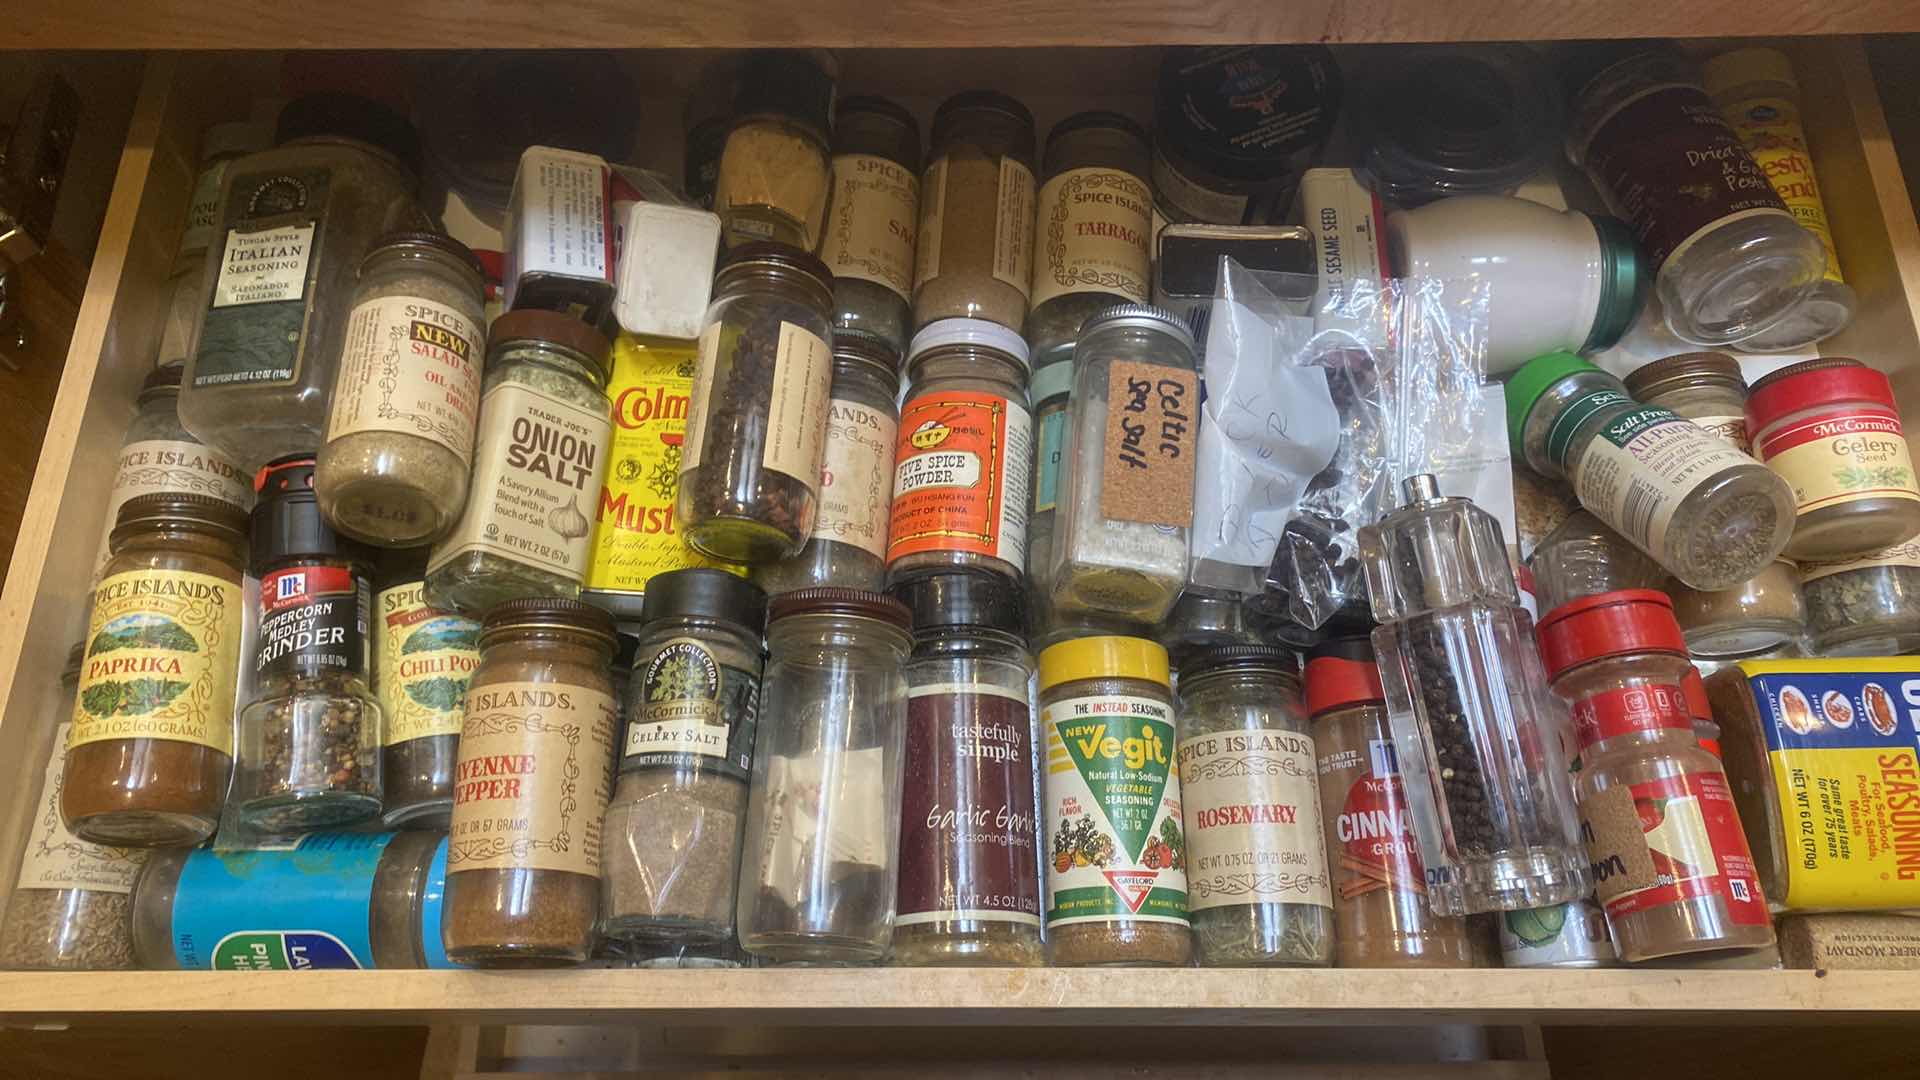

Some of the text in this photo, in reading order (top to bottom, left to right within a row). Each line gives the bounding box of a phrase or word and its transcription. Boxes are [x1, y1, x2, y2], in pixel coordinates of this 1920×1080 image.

[1320, 207, 1342, 274] SESAME SEED
[229, 245, 304, 263] ITALIAN
[227, 260, 299, 276] SEASONING
[404, 304, 466, 332] SPICE
[415, 324, 467, 356] NEW
[410, 342, 460, 370] SALAD
[424, 370, 446, 389] OIL
[528, 406, 562, 427] TRADER
[1156, 379, 1189, 459] Celtic
[1610, 414, 1640, 437] Salt
[1639, 408, 1674, 424] Free
[1813, 418, 1898, 437] McCormick
[512, 417, 596, 470] ONION
[1832, 438, 1898, 458] Celery
[507, 443, 592, 491] SALT
[899, 455, 965, 479] FIVE SPICE
[1855, 453, 1888, 464] Seed
[499, 475, 560, 504] A Savory Allium
[902, 470, 954, 491] POWDER
[496, 489, 546, 513] Blend with a
[494, 503, 545, 528] Touch of Salt
[503, 534, 518, 547] NET
[533, 541, 540, 552] 2
[540, 544, 551, 555] OZ
[132, 579, 226, 607] ISLANDS
[261, 602, 333, 638] PEPPERCORN
[268, 617, 316, 645] MEDLEY
[257, 627, 345, 672] GRINDER
[89, 655, 182, 680] PAPRIKA
[400, 657, 445, 678] CHILI
[646, 643, 718, 690] GOURMET COLLECTION
[1074, 702, 1166, 719] THE INSTEAD SEASONING
[111, 720, 132, 732] OZ
[632, 729, 721, 745] CELERY SALT
[952, 723, 1022, 748] tastefully
[1065, 724, 1096, 738] NEW
[957, 740, 1020, 763] simple
[1078, 724, 1169, 770] Vegit
[1088, 769, 1163, 784] Natural Low-Sodium
[1792, 768, 1806, 789] NET
[1105, 784, 1153, 795] VEGETABLE
[1105, 793, 1154, 806] SEASONING
[1797, 793, 1809, 808] WT
[1857, 774, 1871, 817] Poultry,
[1058, 805, 1082, 818] FLAVOR
[1062, 797, 1077, 808] RICH
[496, 817, 529, 832] GRAMS
[926, 804, 991, 830] Garlic
[1197, 804, 1297, 830] ROSEMARY
[1801, 821, 1814, 835] OZ
[1818, 777, 1838, 859] for over 75 years
[1829, 778, 1850, 860] Same great taste
[1849, 800, 1862, 836] Meats
[1871, 782, 1890, 853] For Seafood,
[1877, 752, 1917, 882] SEASONING
[950, 832, 1008, 846] Seasoning
[1198, 856, 1209, 871] NET
[1224, 853, 1241, 866] 0.75
[1281, 852, 1308, 865] GRAMS
[1801, 838, 1818, 870] (170g)
[939, 895, 1016, 907] NET WT 4.5 OZ
[1825, 945, 1881, 957] MONDAVI
